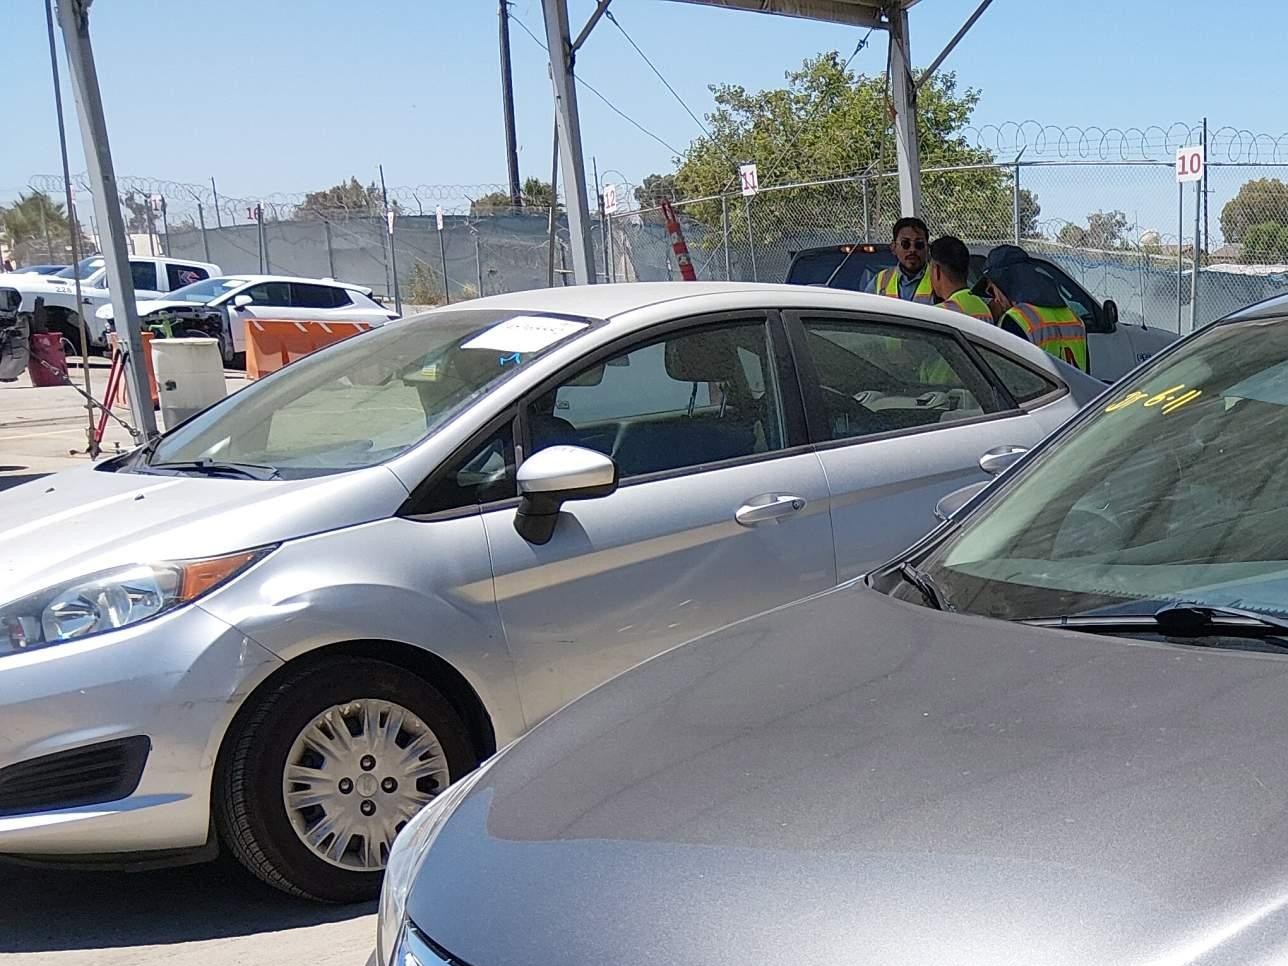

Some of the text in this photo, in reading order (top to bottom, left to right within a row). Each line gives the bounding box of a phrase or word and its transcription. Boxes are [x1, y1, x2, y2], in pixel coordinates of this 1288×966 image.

[1177, 152, 1201, 175] 10
[741, 171, 758, 190] 11
[605, 189, 616, 209] 12
